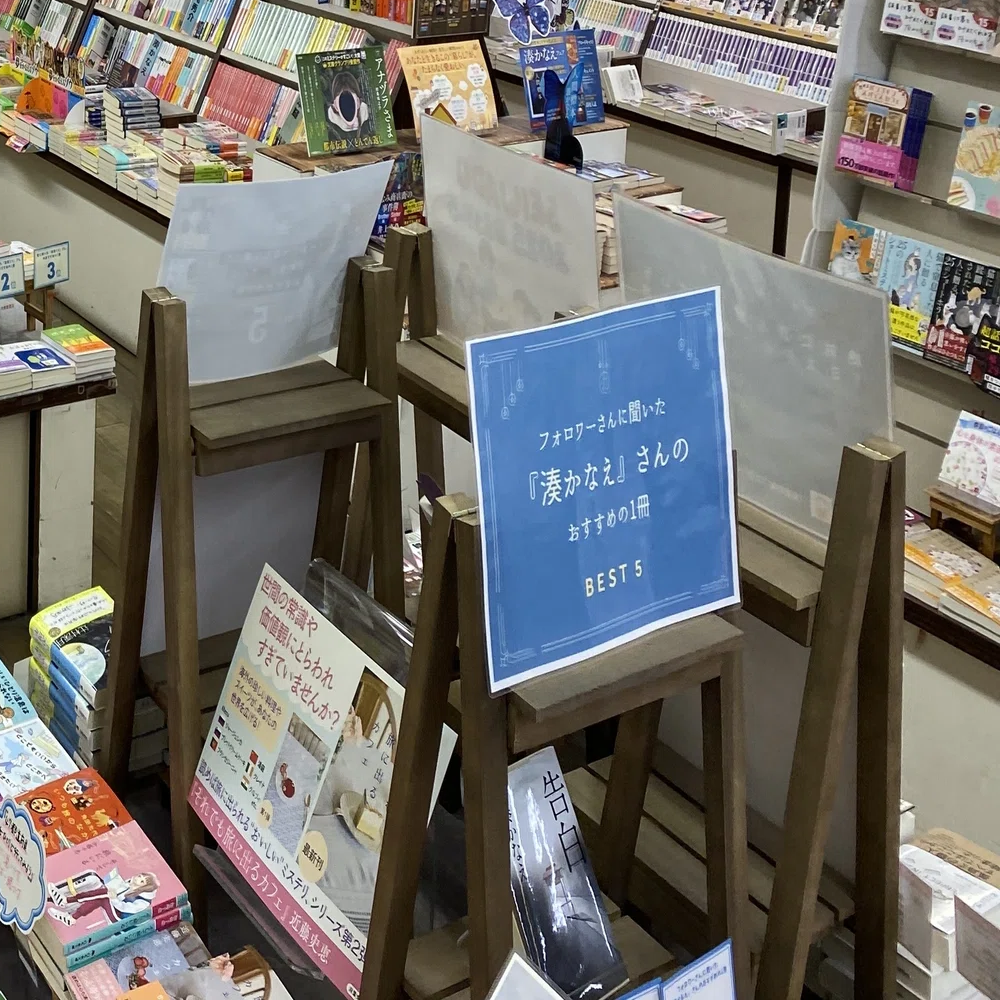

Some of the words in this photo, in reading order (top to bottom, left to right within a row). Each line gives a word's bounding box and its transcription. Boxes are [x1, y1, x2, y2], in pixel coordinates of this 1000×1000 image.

[924, 7, 936, 17] 15
[979, 18, 989, 28] 15
[139, 38, 160, 76] 湊かなえ
[523, 47, 557, 64] 湊かなえ
[375, 58, 394, 139] アナヅラさま
[539, 397, 667, 451] フォロワーさんに聞いた
[529, 455, 626, 507] 『湊かなえ』
[637, 437, 689, 474] さんの
[568, 494, 650, 543] おすすめの1冊
[259, 572, 319, 635] 世間の常識や
[585, 563, 629, 598] BEST
[635, 559, 643, 579] 5
[258, 605, 334, 691] 価値観にとらわれ
[257, 637, 340, 732] すぎていませんか?
[368, 733, 396, 800] 旅に出る
[542, 770, 588, 873] 告白
[301, 842, 325, 872] 最新刊
[288, 910, 333, 965] 近藤史恵
